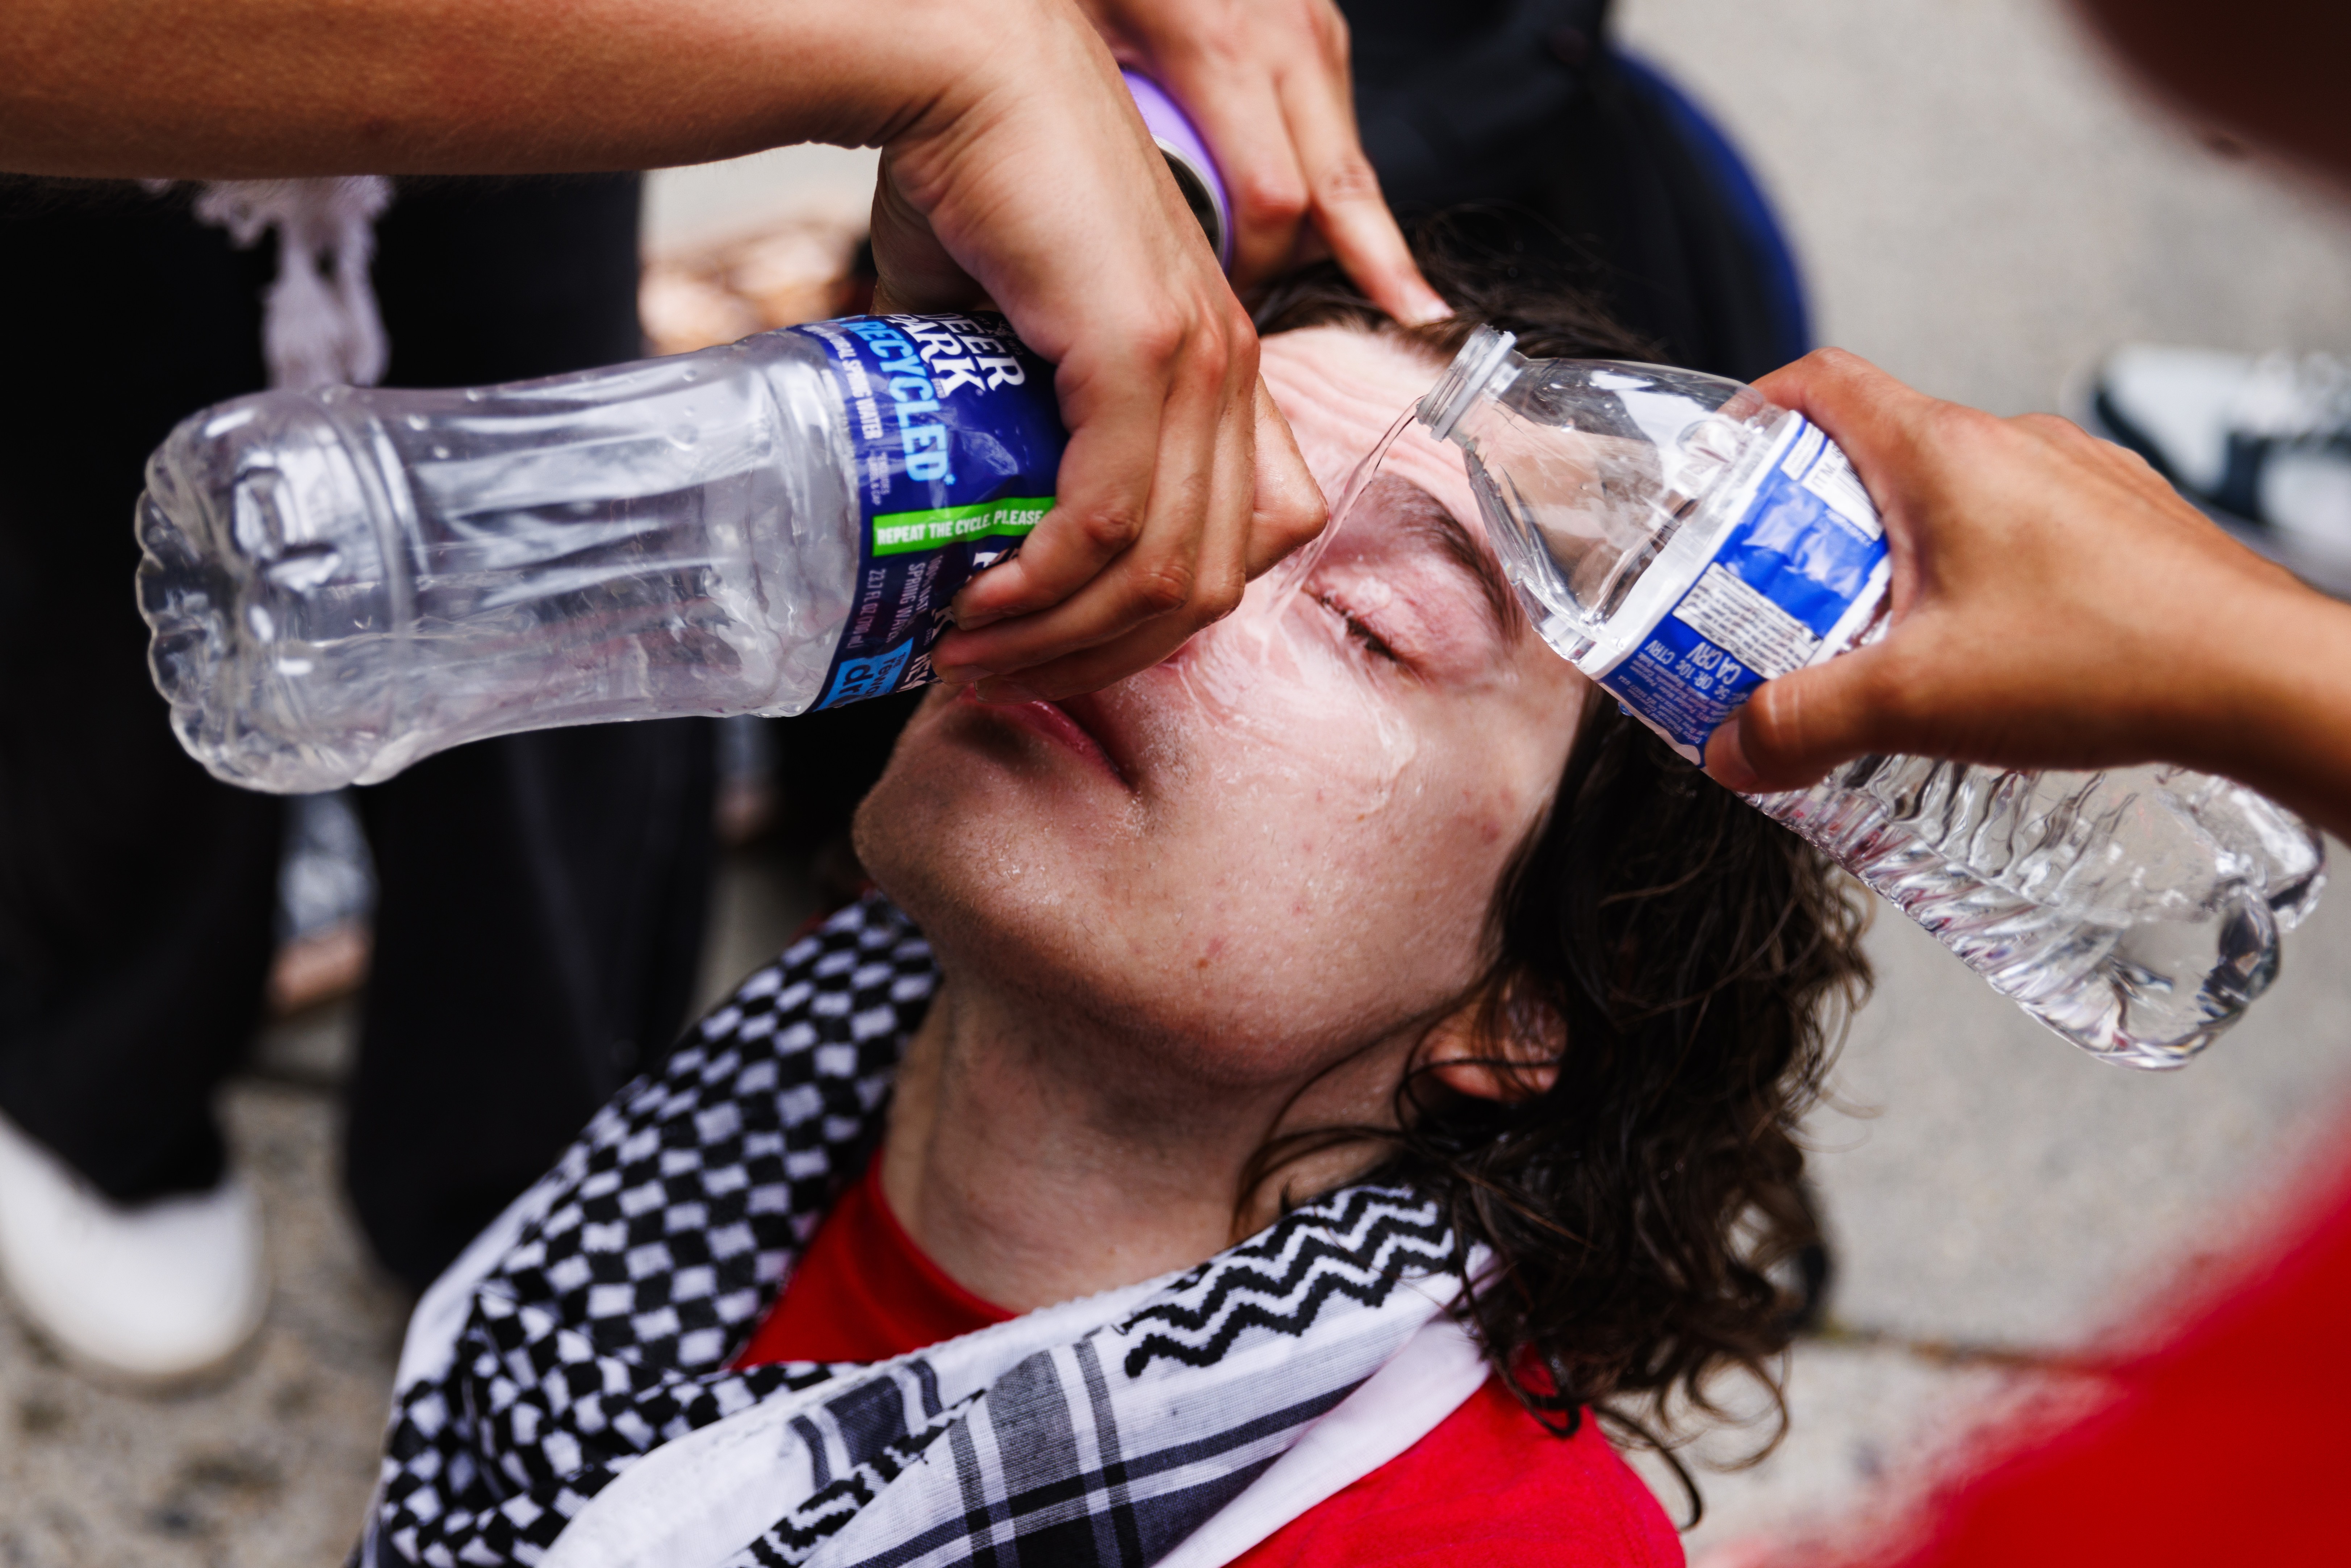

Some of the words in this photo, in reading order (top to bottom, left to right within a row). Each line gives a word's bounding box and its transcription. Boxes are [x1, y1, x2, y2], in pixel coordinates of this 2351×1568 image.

[889, 314, 986, 397] PARK
[942, 313, 1025, 392] DEER
[819, 331, 857, 360] NATURAL
[841, 358, 873, 397] SPRING
[857, 397, 883, 440] WATER
[877, 517, 925, 545] REPEAT
[930, 519, 953, 540] THE
[863, 591, 880, 602] FL
[899, 562, 925, 604] SPRING
[860, 603, 878, 615] OZ
[885, 606, 913, 643] WATER
[1683, 641, 1724, 670] CRV
[1618, 674, 1631, 686] USA
[1713, 656, 1742, 685] CA
